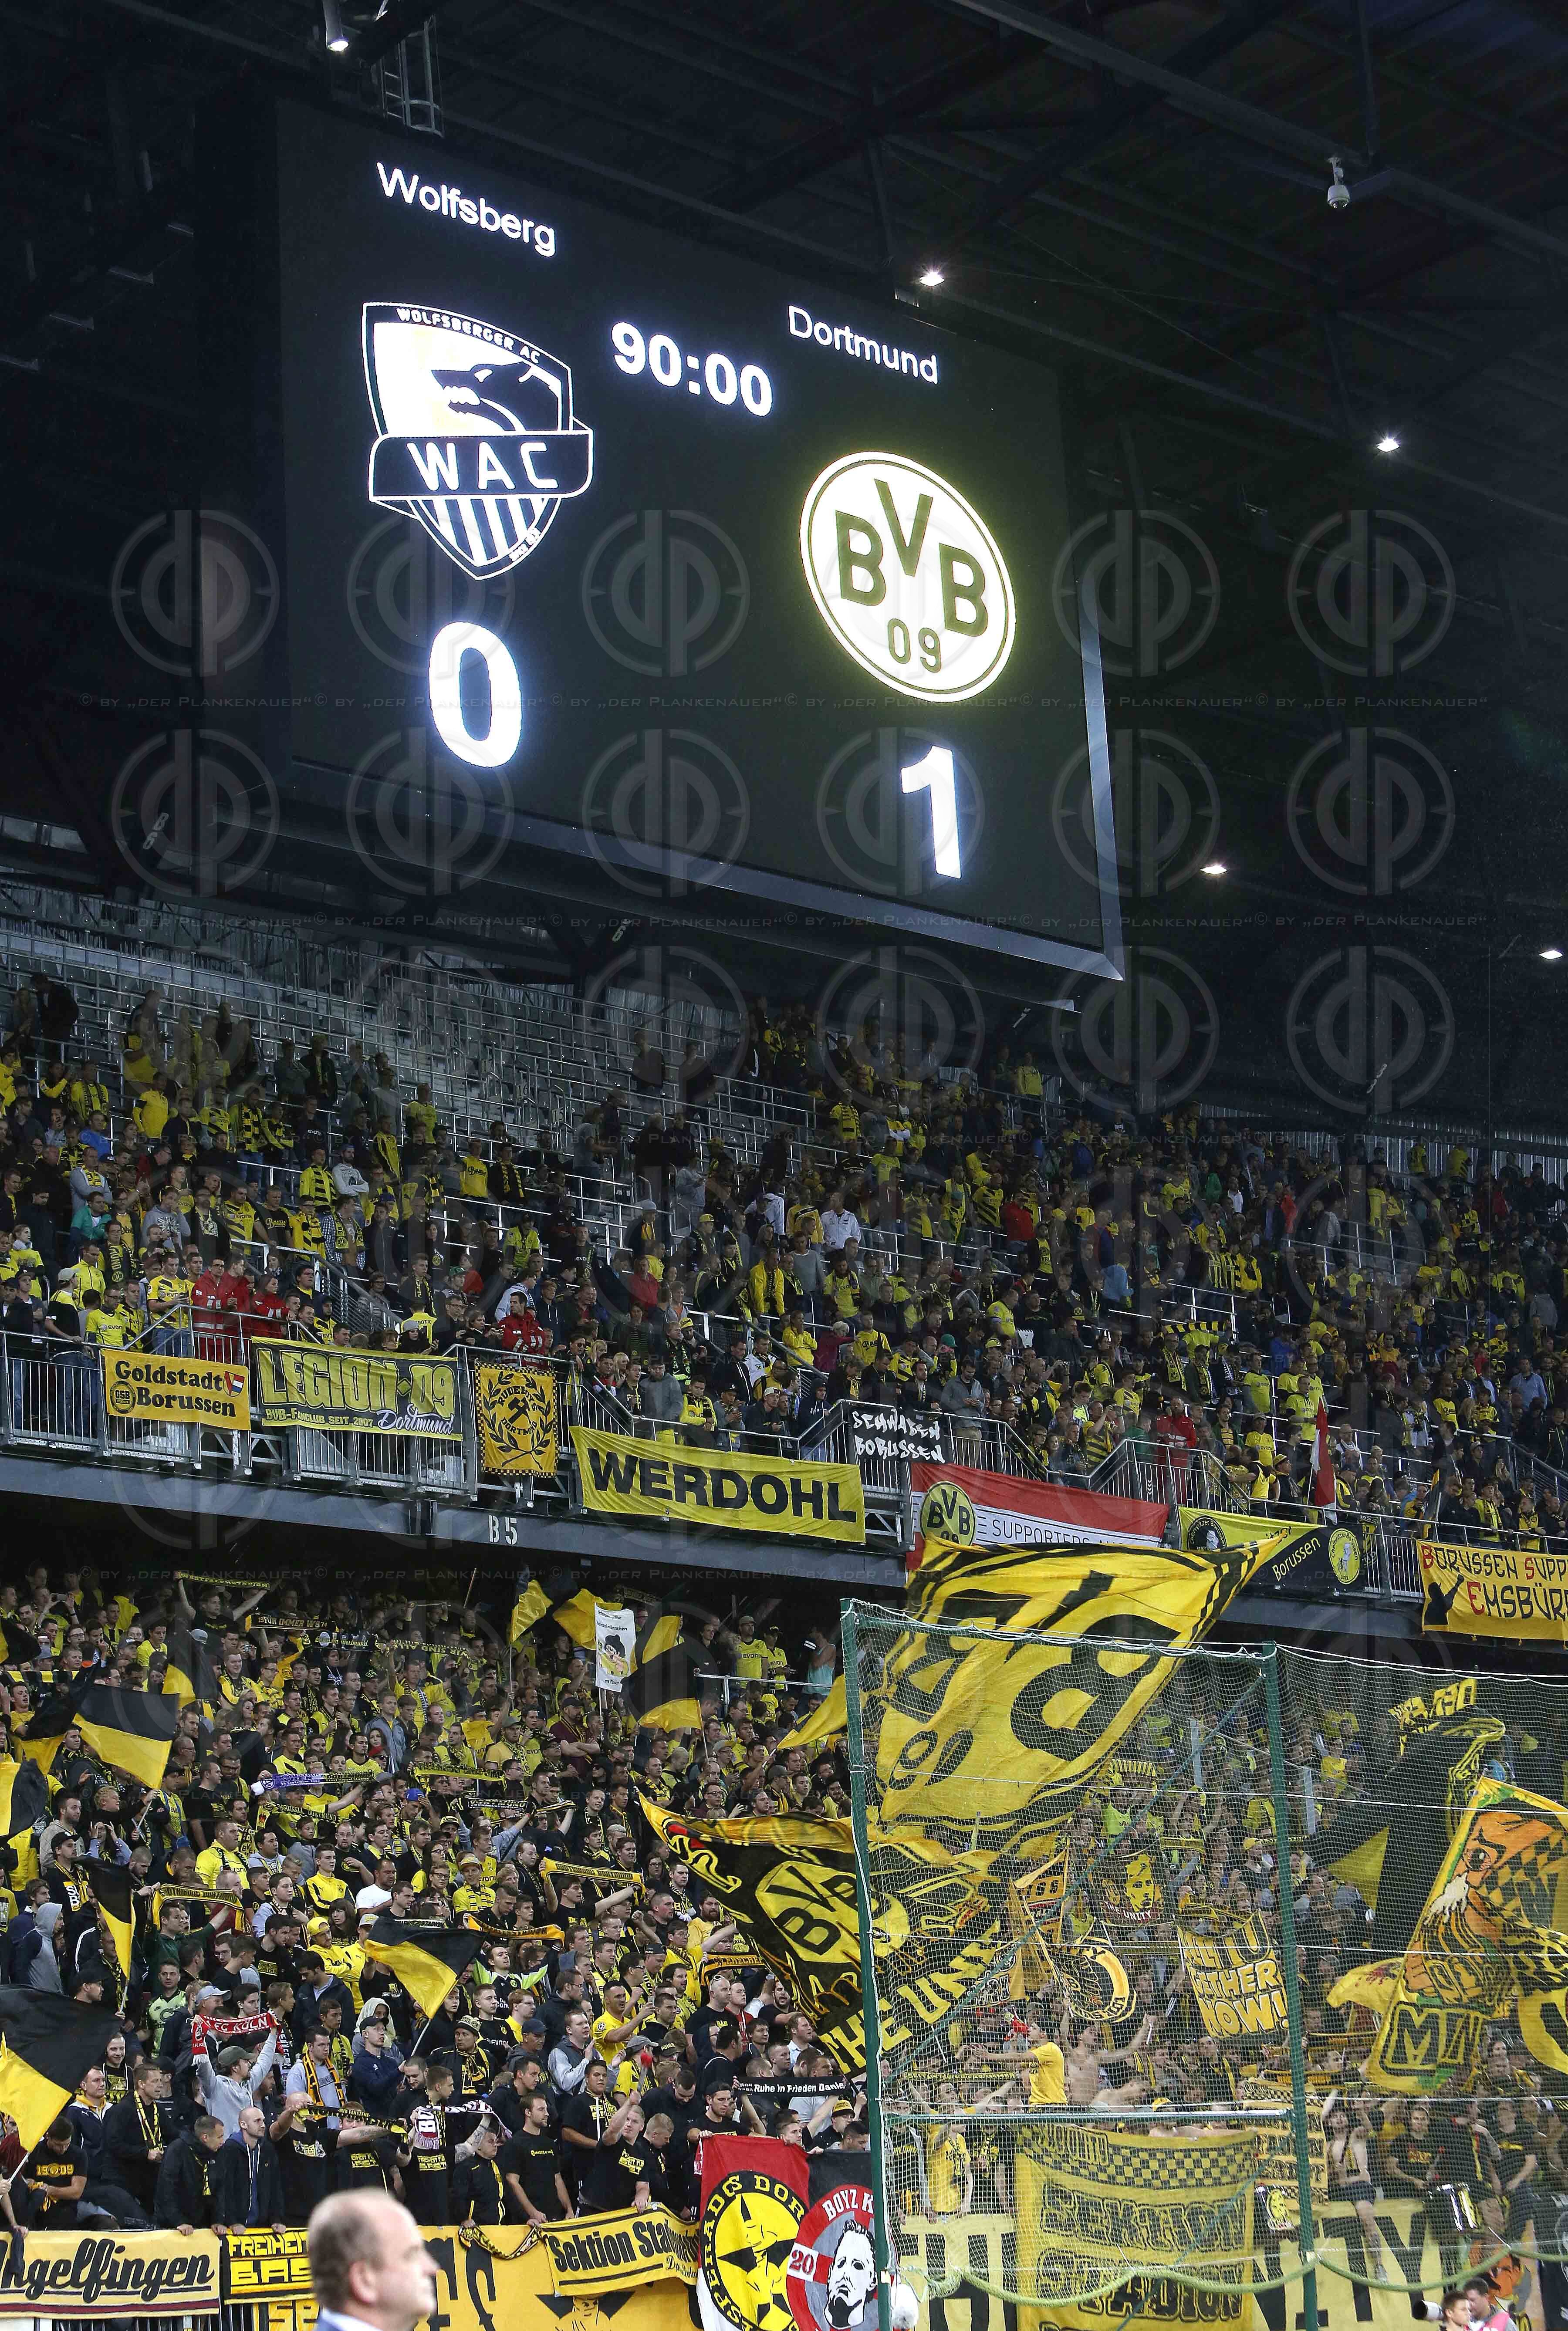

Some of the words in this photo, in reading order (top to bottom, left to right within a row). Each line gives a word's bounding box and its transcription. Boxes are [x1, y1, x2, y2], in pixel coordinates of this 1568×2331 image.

[376, 161, 556, 257] Wolfsberg
[396, 308, 515, 351] WOLFSBERGER
[519, 345, 541, 364] AC
[788, 304, 939, 385] Dortmund
[611, 321, 773, 417] 90:00
[406, 442, 558, 491] WAC
[835, 478, 988, 637] BVB
[887, 618, 942, 673] 09
[429, 621, 522, 767] 0
[900, 744, 962, 880] 1
[115, 1361, 223, 1390] Goldstadt
[115, 1390, 130, 1400] GSB
[256, 1348, 399, 1414] LEGION
[408, 1363, 456, 1420] 09
[136, 1387, 236, 1417] Borussen
[328, 1415, 349, 1425] SEIT
[353, 1417, 373, 1428] 2007
[376, 1404, 455, 1436] Dortmund
[852, 1408, 940, 1441] SCHWABEN
[854, 1434, 946, 1464] BORUSSEN
[588, 1448, 858, 1524] WERDOHL
[927, 1488, 970, 1536] BVB
[1272, 1537, 1321, 1581] Borussen
[1421, 1545, 1519, 1579] BORUSSEN
[307, 1810, 337, 1822] DORTMUND
[1105, 1900, 1122, 1915] THE
[1123, 1909, 1152, 1921] UNITY
[1189, 1960, 1279, 2000] GETHER
[233, 2015, 267, 2030] KÖLN
[1198, 1990, 1291, 2039] NOW!
[754, 2084, 776, 2093] Ruhe
[787, 2084, 817, 2093] Frieden
[821, 2188, 858, 2221] BOYZ
[549, 2231, 637, 2273] Sektion
[788, 2249, 814, 2276] 20
